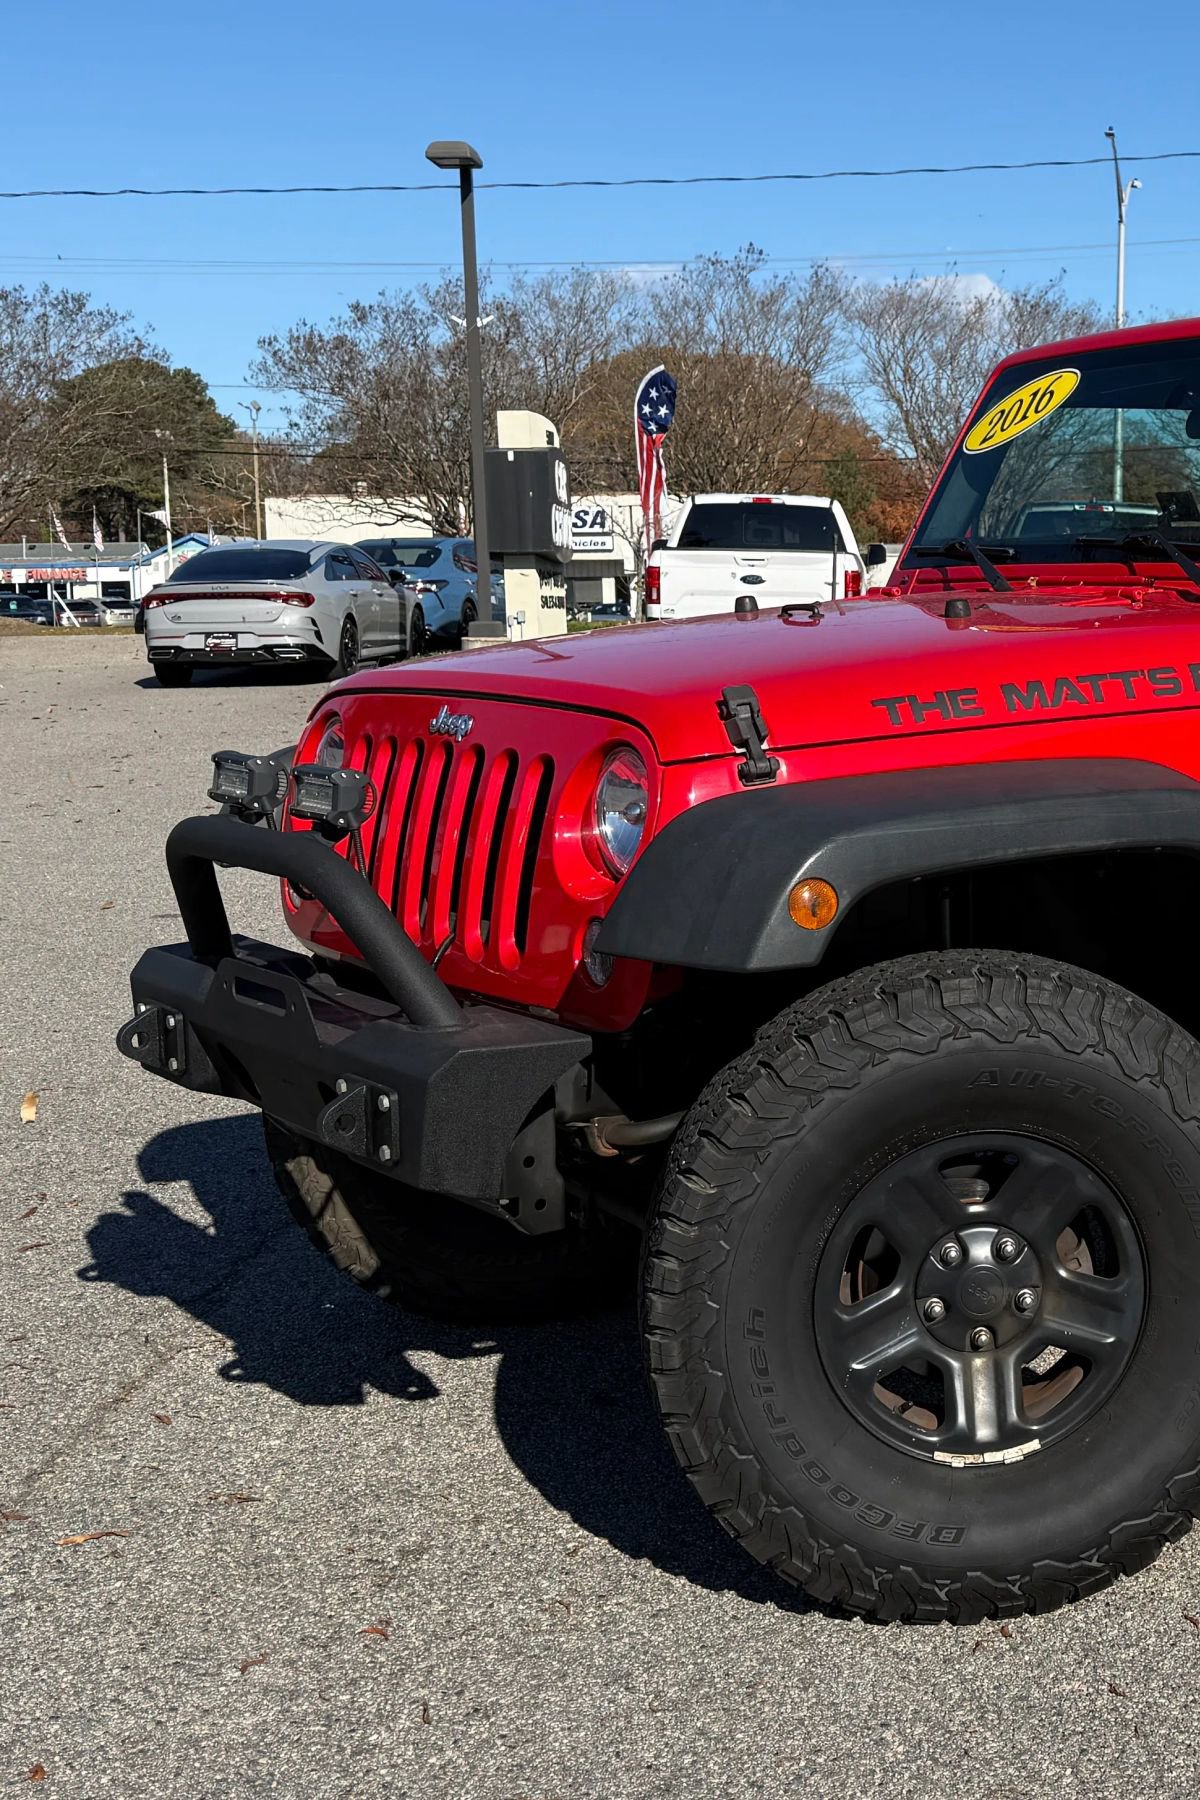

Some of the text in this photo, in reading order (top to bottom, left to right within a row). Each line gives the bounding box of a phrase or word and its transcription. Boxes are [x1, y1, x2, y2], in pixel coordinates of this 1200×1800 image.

[979, 375, 1063, 446] 2016
[26, 568, 88, 581] FINANCE
[430, 704, 474, 742] Jeep
[872, 688, 984, 726] THE
[999, 666, 1182, 712] MATT'S
[743, 1306, 969, 1548] BFGoodrich
